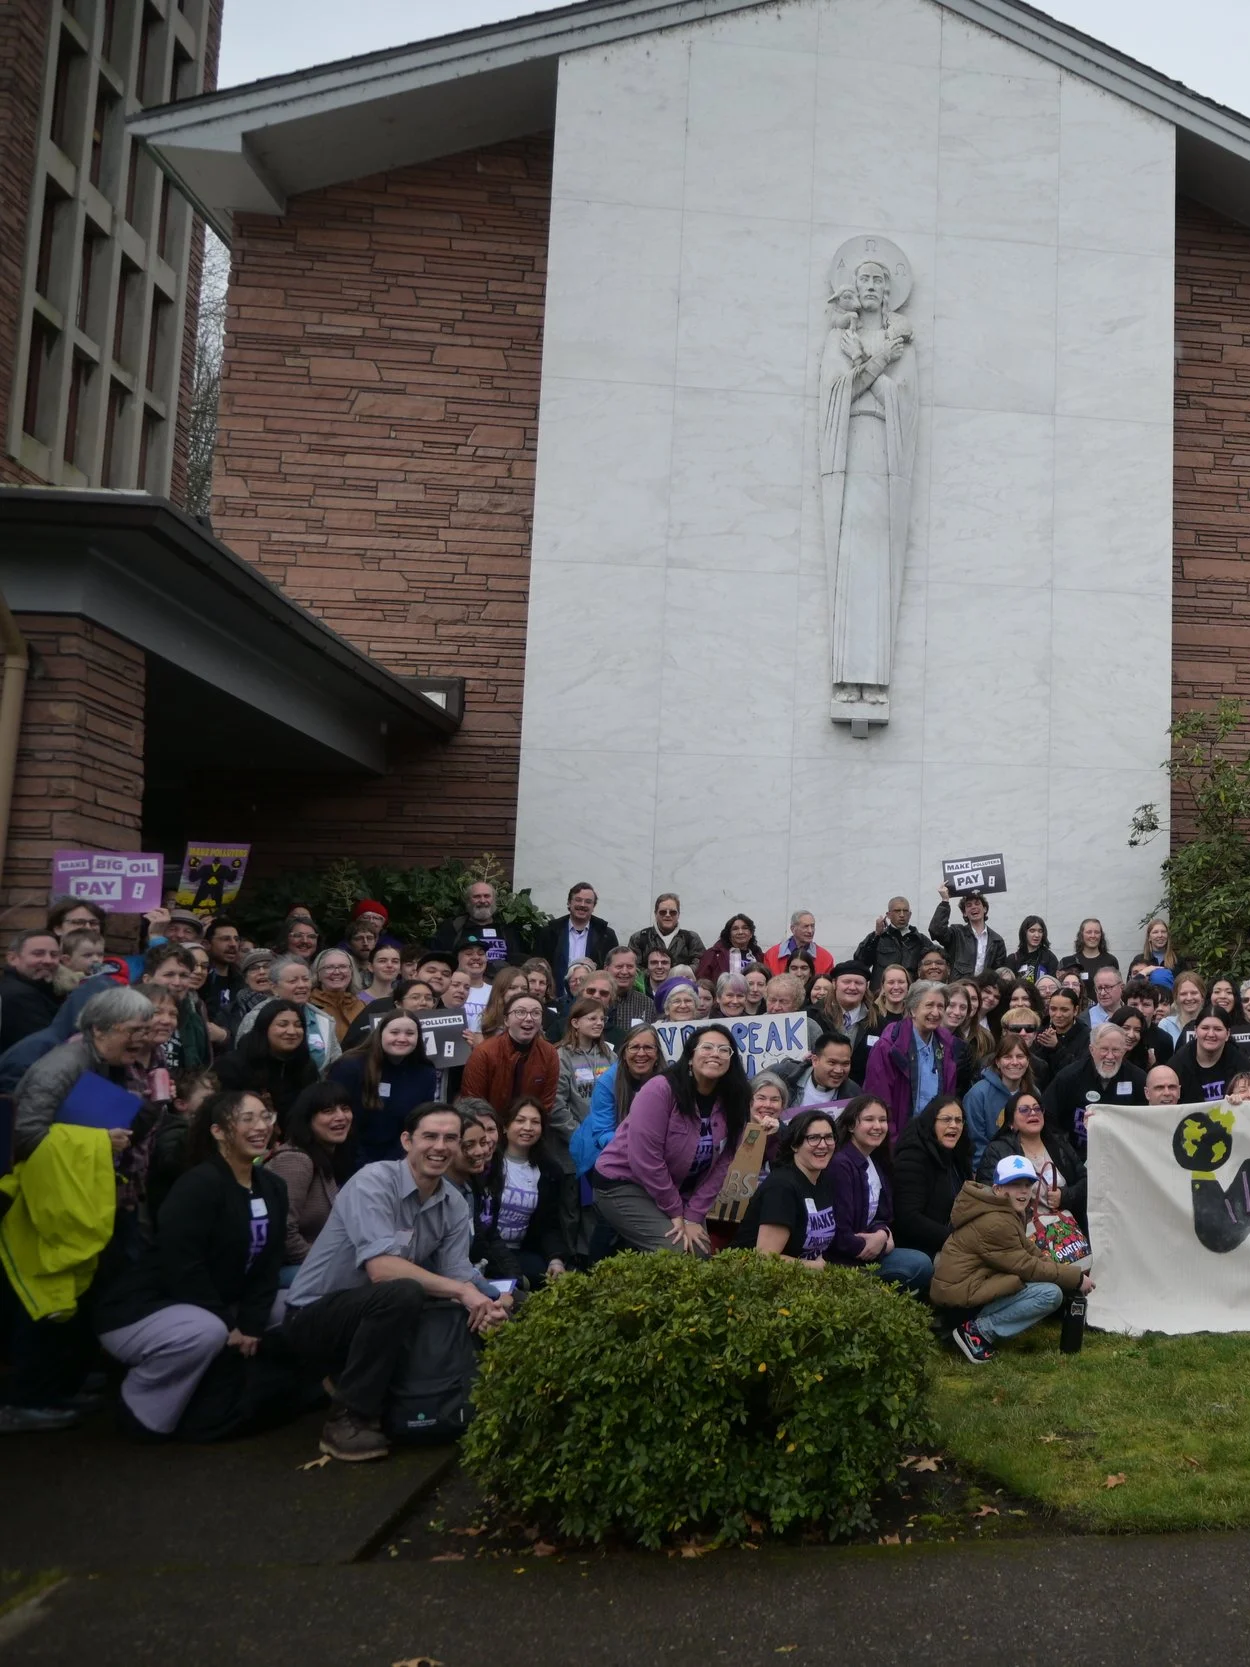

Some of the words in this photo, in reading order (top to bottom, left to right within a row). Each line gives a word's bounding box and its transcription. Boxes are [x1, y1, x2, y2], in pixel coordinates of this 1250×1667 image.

[96, 859, 123, 870] BIG
[129, 863, 154, 873] OIL
[946, 862, 970, 871] MAKE
[957, 873, 980, 886] PAY
[75, 881, 116, 895] PAY
[732, 1017, 805, 1055] REAK
[809, 1211, 835, 1231] MAKE
